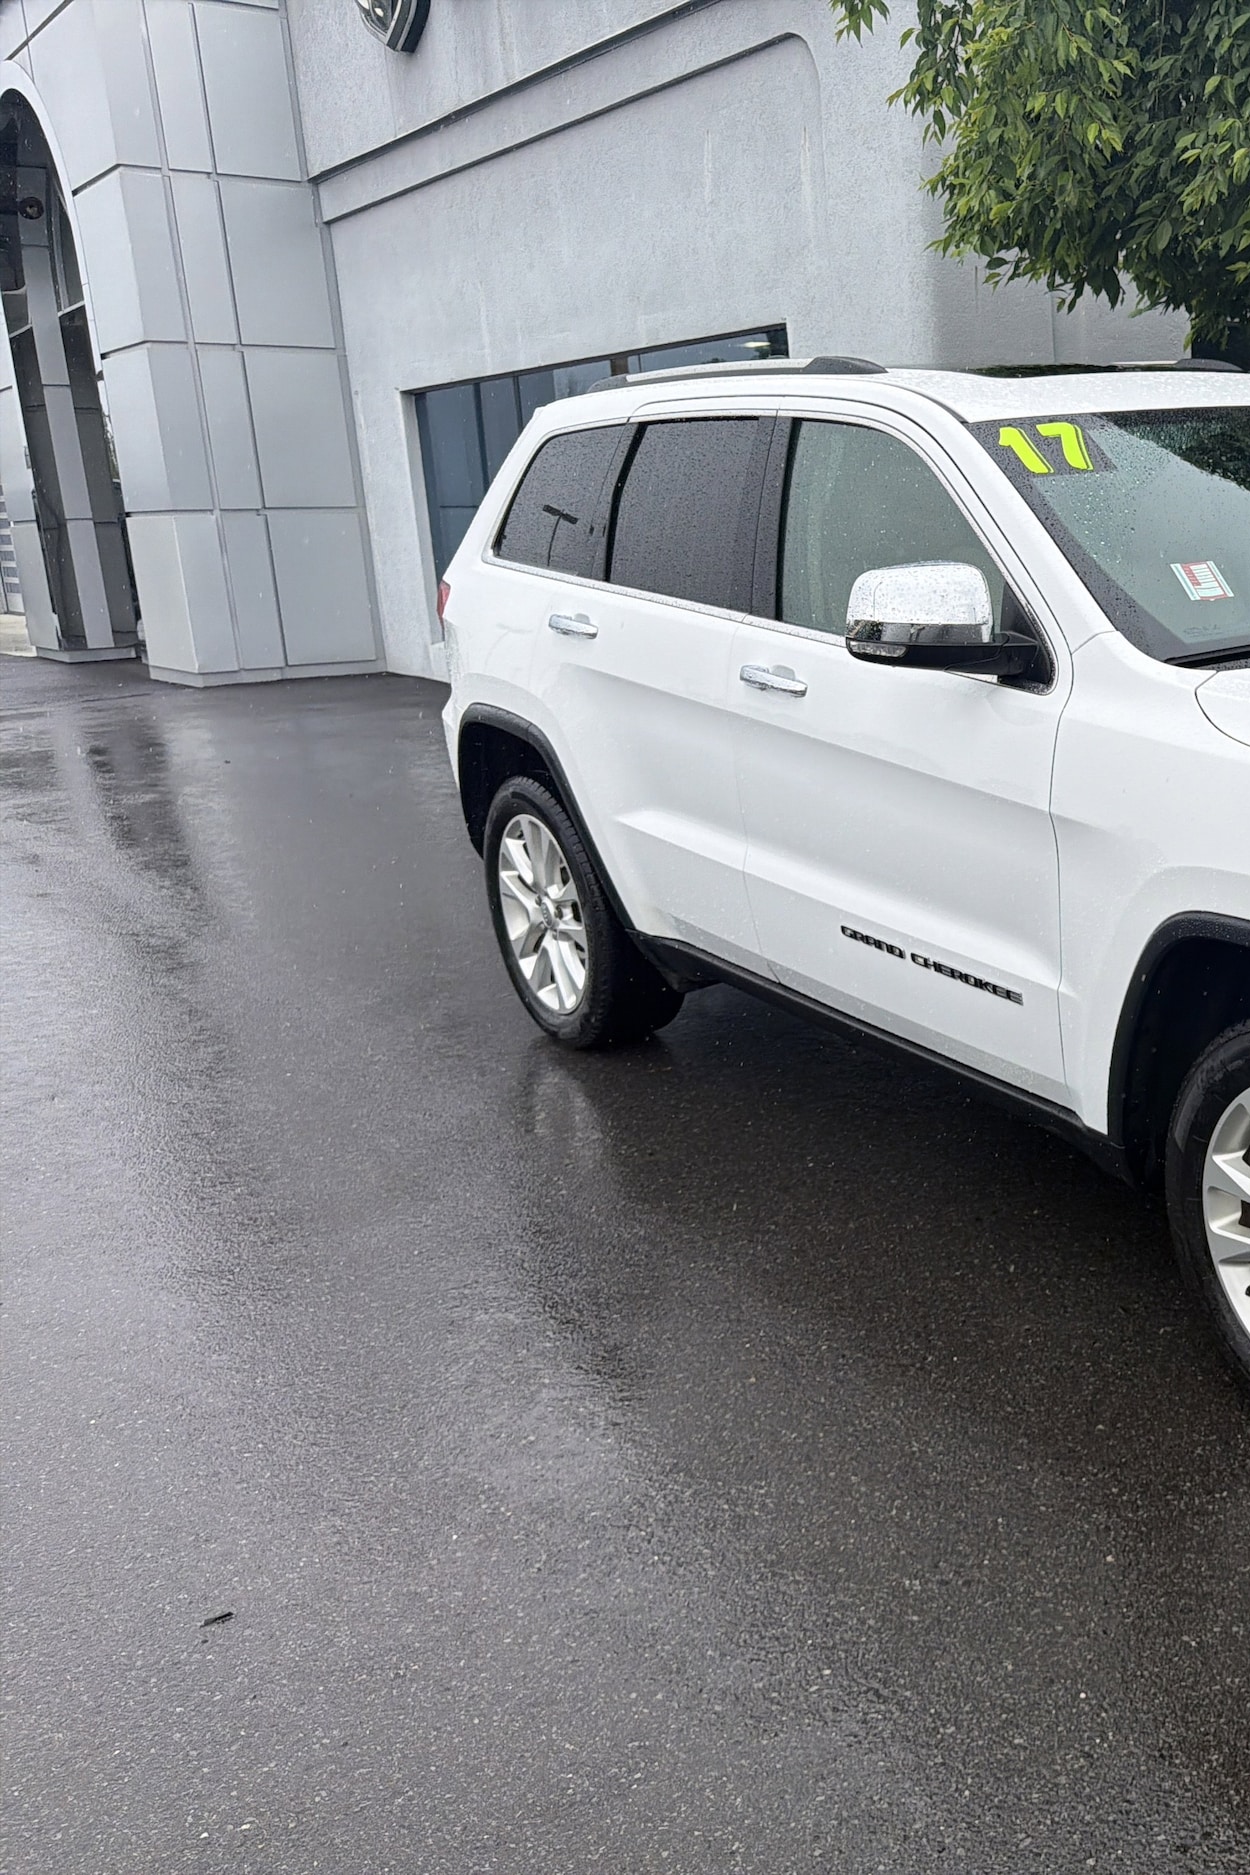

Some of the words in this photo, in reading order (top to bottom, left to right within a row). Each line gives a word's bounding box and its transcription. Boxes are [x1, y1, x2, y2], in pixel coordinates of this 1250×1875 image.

[998, 421, 1093, 474] 17
[840, 924, 906, 960] GRAND
[910, 952, 1025, 1007] CHEROKEE
